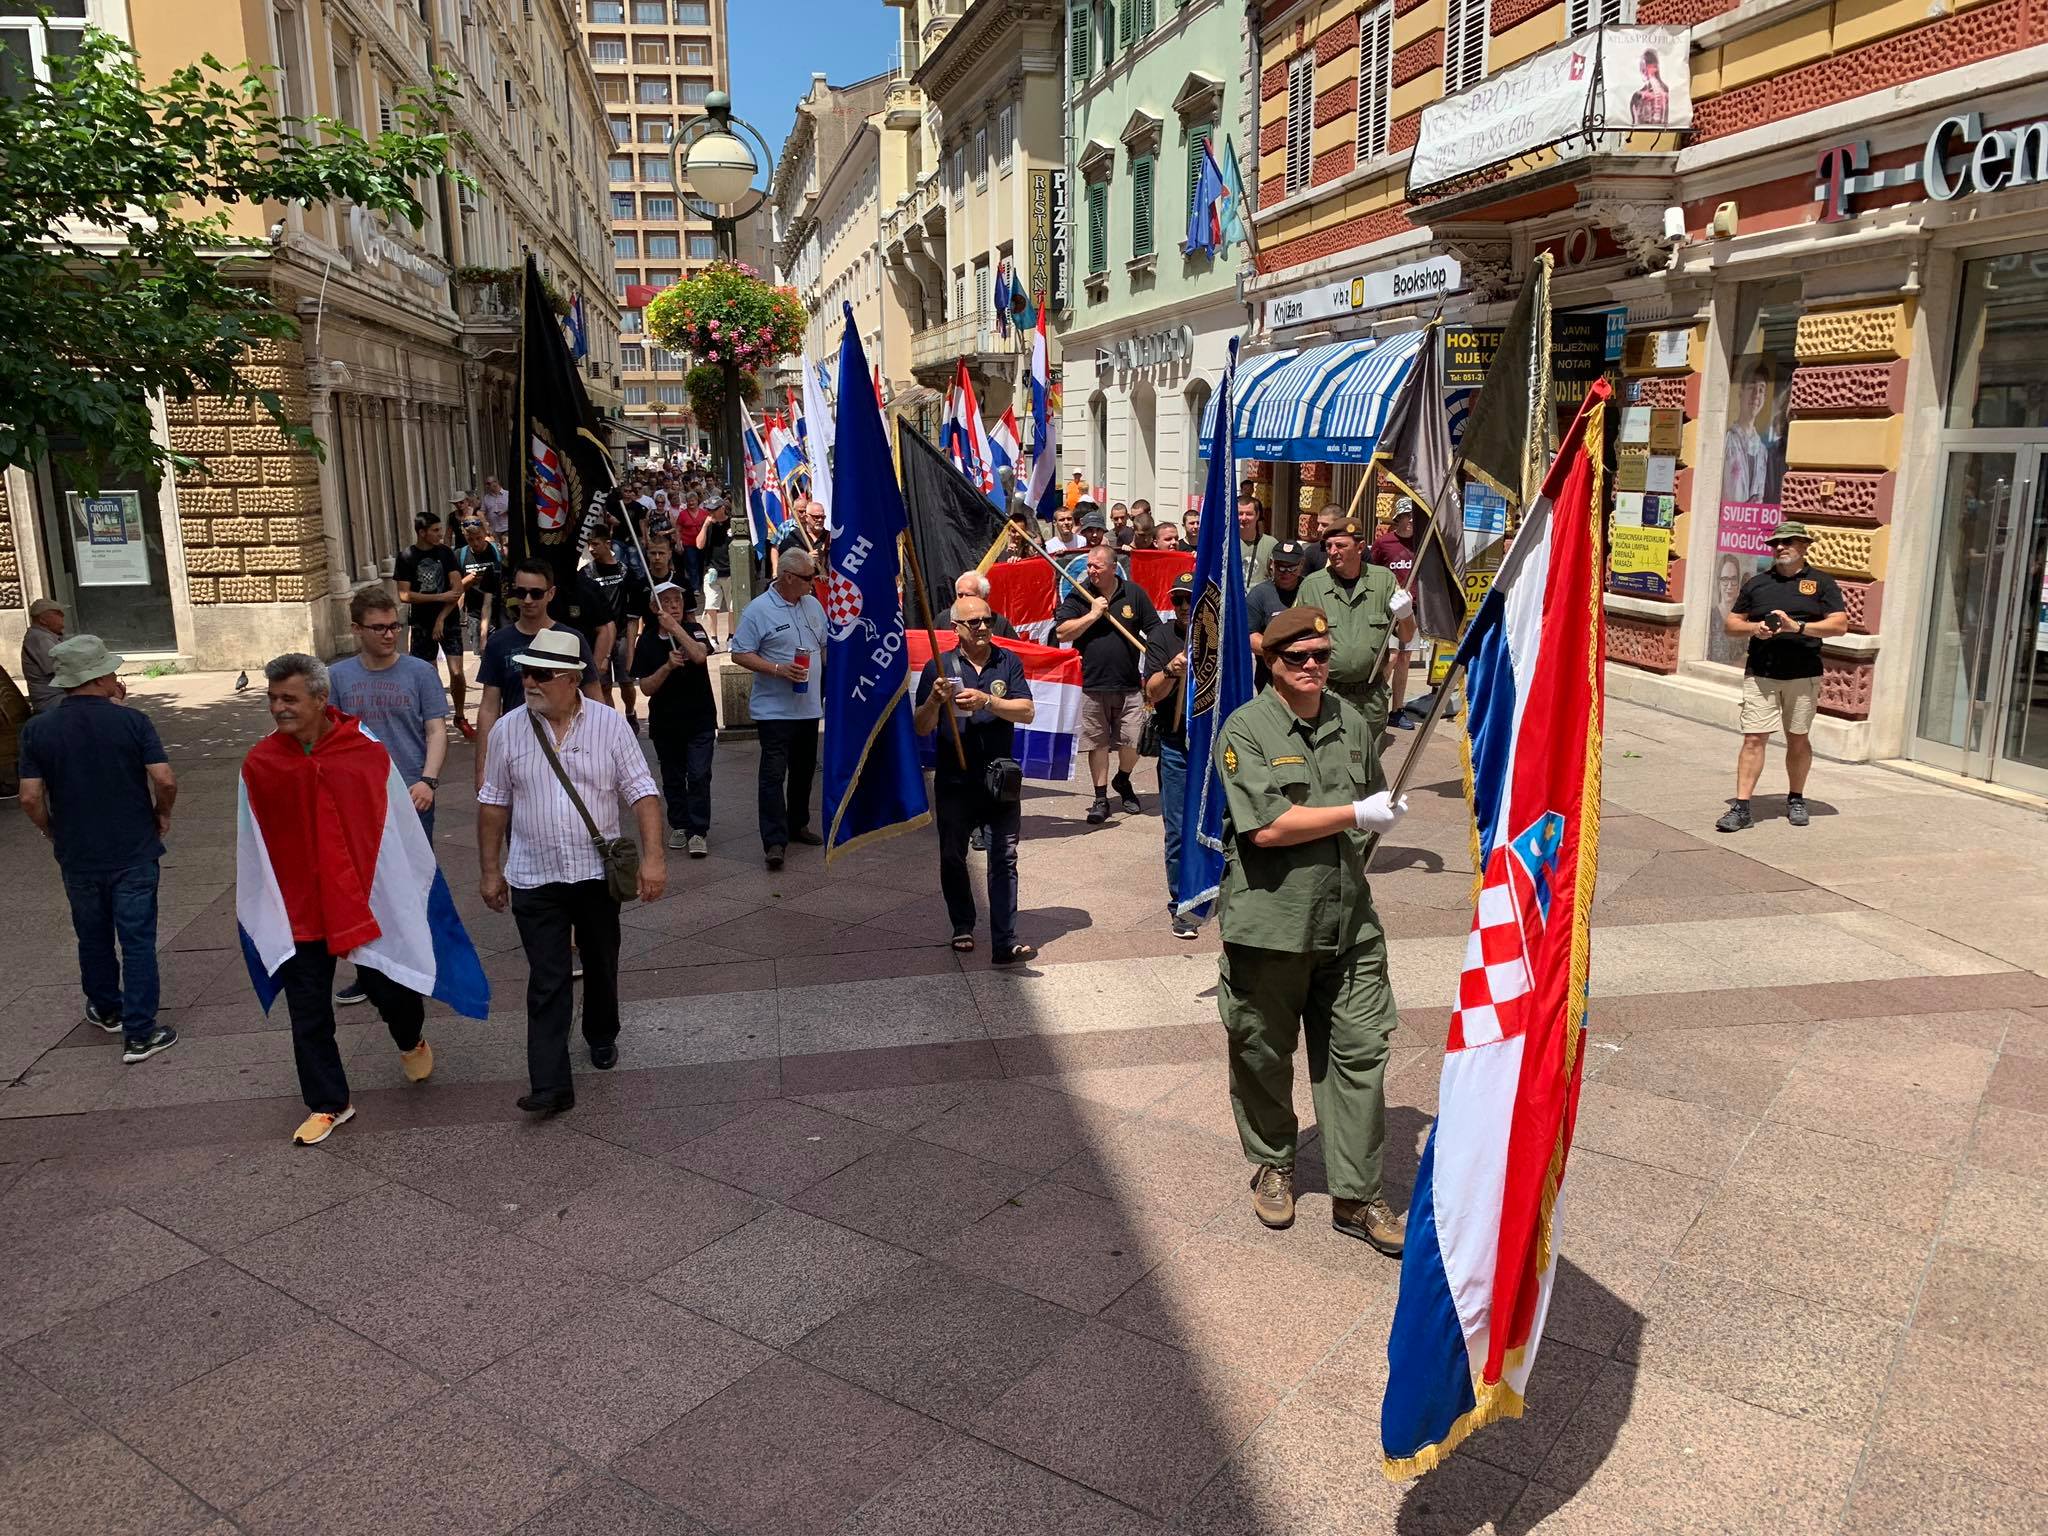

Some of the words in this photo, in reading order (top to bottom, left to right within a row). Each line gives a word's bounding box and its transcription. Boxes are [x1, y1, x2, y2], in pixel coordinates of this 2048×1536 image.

[1508, 112, 1535, 145] 606
[1053, 172, 1068, 256] PIZZA
[1274, 302, 1303, 324] Knjižara
[1393, 267, 1446, 295] Bookshop
[1562, 326, 1590, 336] JAVNI
[1557, 359, 1591, 369] NOTAR
[1463, 373, 1488, 382] 051-21
[89, 504, 120, 512] CROATIA
[1723, 506, 1759, 523] SVIJET
[842, 535, 874, 575] RH
[851, 674, 881, 702] 71.
